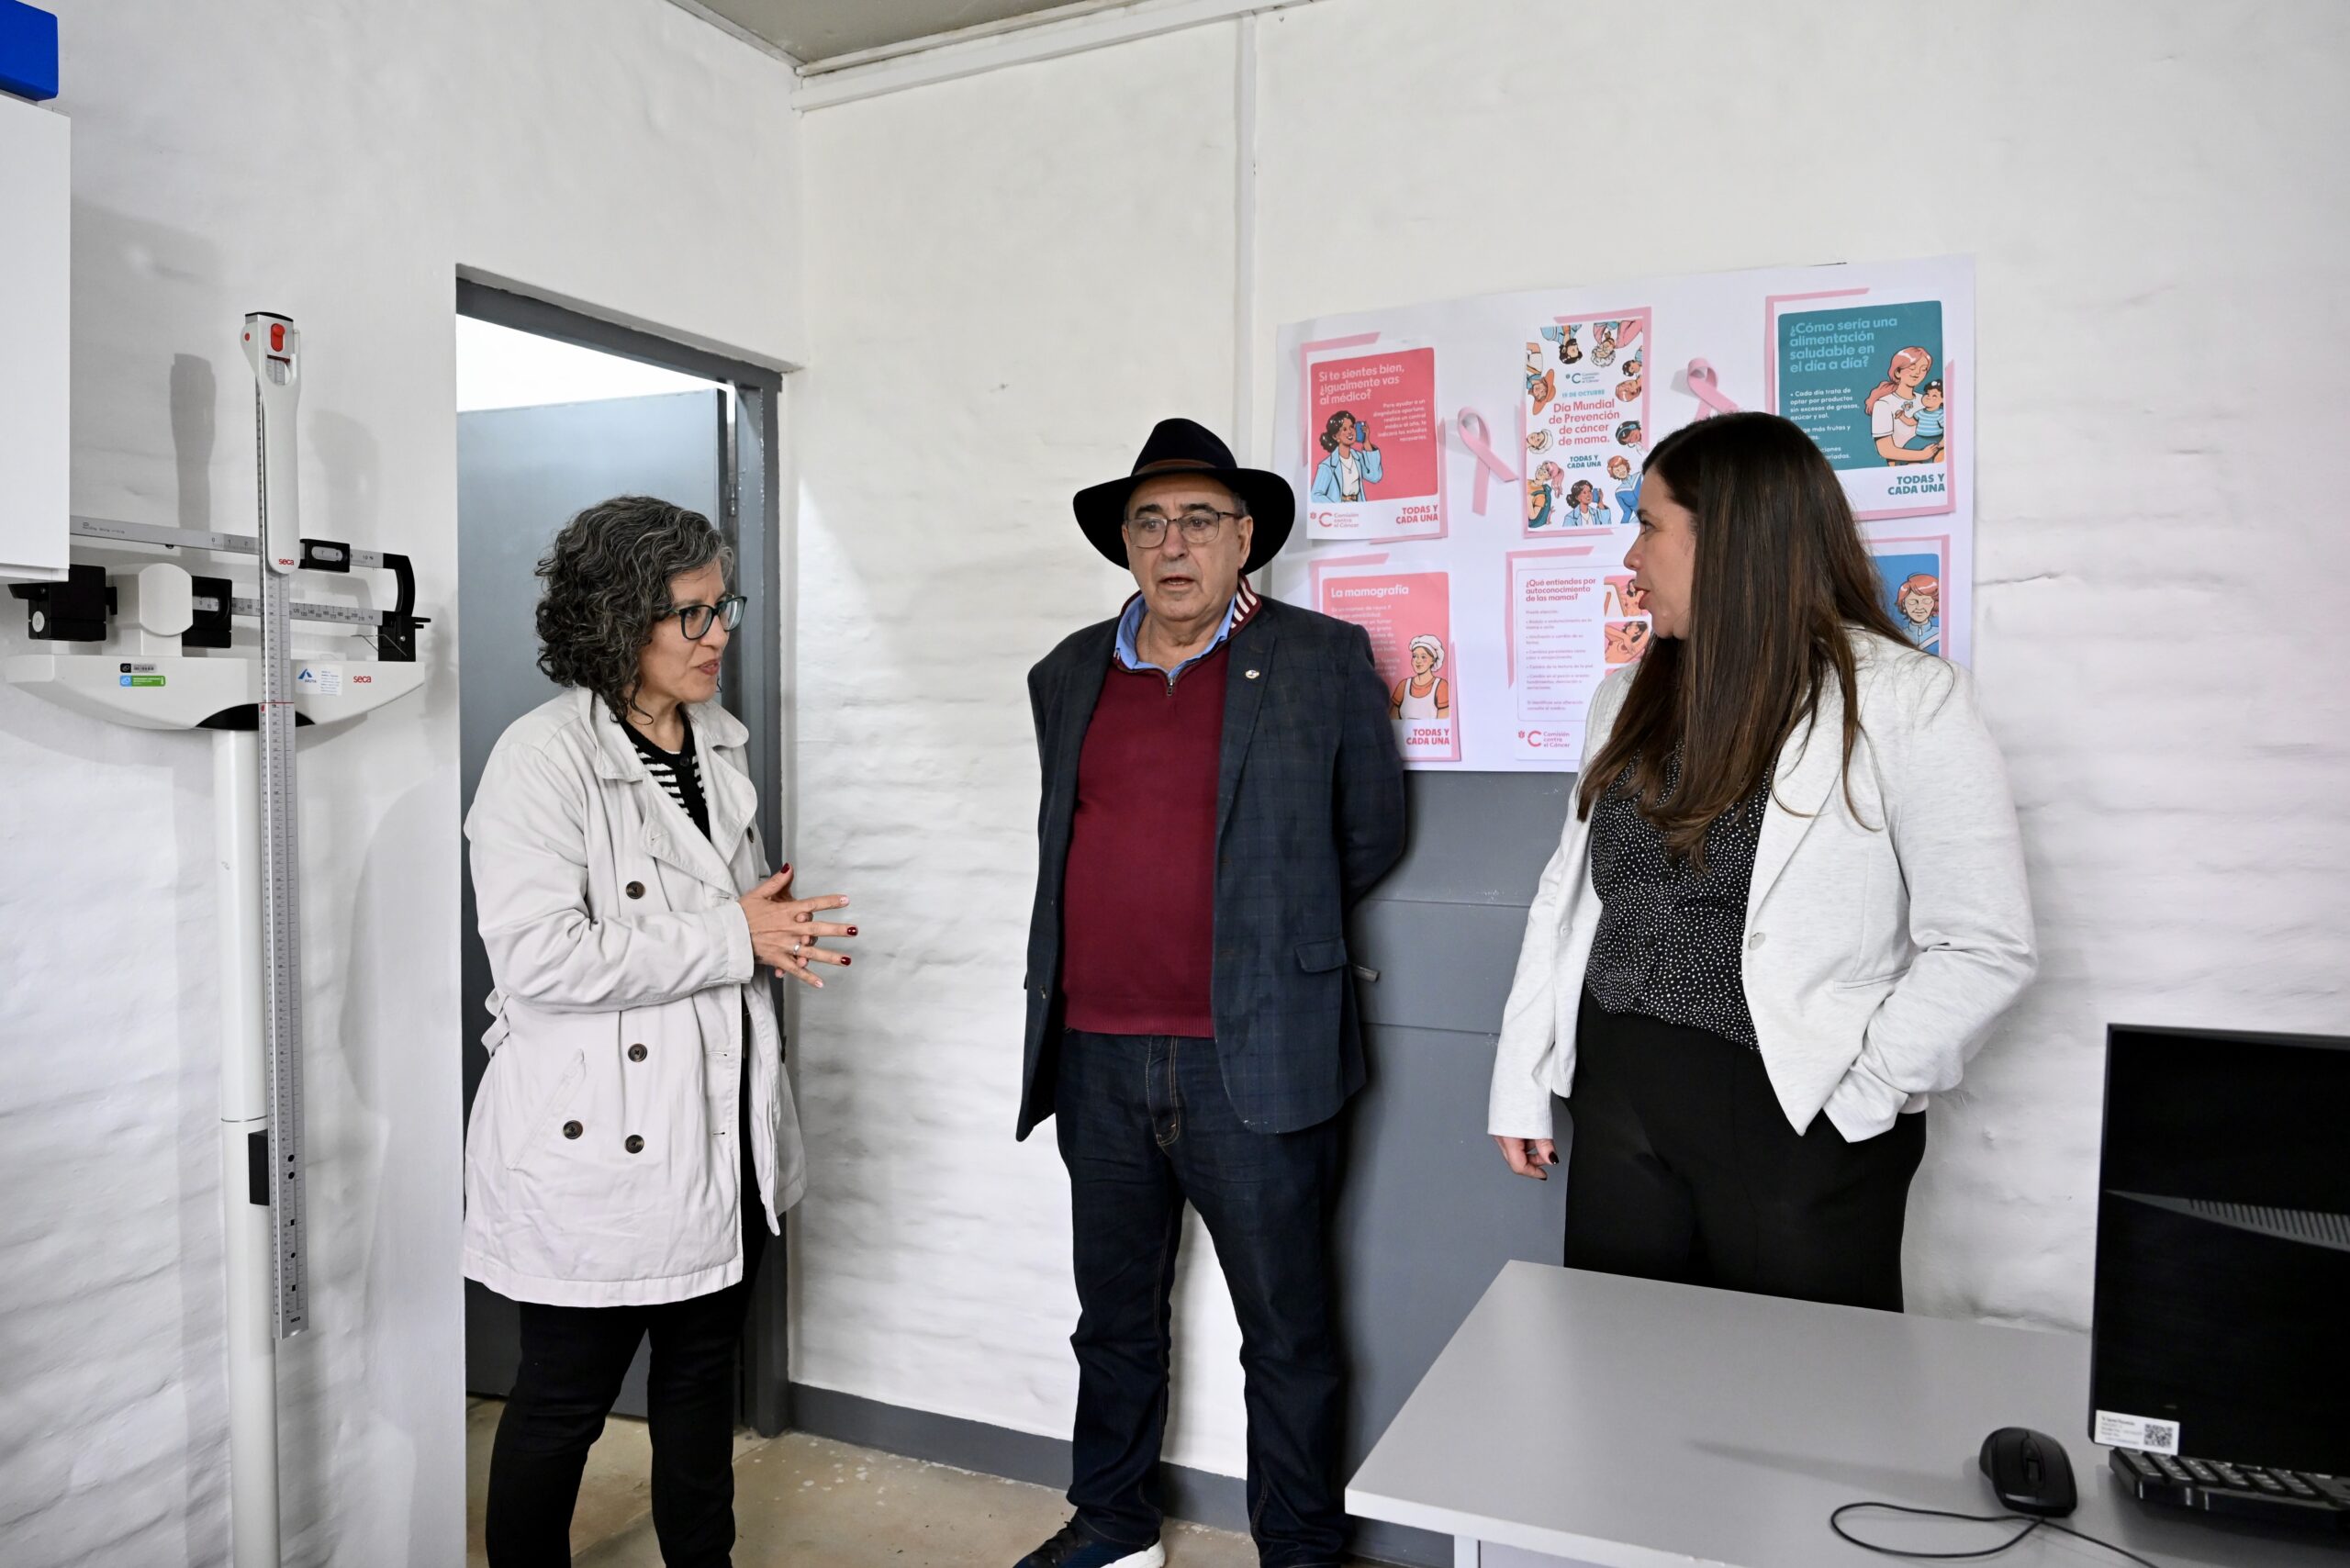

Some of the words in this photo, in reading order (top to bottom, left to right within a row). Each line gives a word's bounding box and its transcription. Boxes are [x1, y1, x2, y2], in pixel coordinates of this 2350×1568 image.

[1789, 321, 1835, 337] ¿Cómo
[1837, 318, 1870, 330] sería
[1873, 318, 1897, 328] una
[1789, 330, 1874, 347] alimentación
[1789, 344, 1855, 360] saludable
[1858, 345, 1874, 354] en
[1790, 361, 1802, 373] el
[1805, 359, 1826, 372] día
[1829, 361, 1838, 370] a
[1841, 355, 1869, 369] día?
[1319, 371, 1327, 382] Si
[1329, 372, 1340, 380] te
[1341, 367, 1377, 379] sientes
[1380, 364, 1404, 375] bien,
[1320, 378, 1380, 396] ¿igualmente
[1382, 376, 1400, 386] vas
[1320, 395, 1329, 405] al
[1331, 389, 1371, 404] médico?
[1553, 402, 1572, 413] Día
[1573, 398, 1615, 411] Mundial
[1549, 415, 1562, 424] de
[1564, 410, 1620, 422] Prevención
[1559, 425, 1572, 435] de
[1574, 423, 1609, 433] cáncer
[1559, 436, 1572, 446] de
[1574, 435, 1610, 445] mama.
[1897, 474, 1934, 485] TODAS
[1937, 473, 1944, 482] Y
[1887, 485, 1918, 495] CADA
[1920, 483, 1945, 493] UNA
[1402, 505, 1430, 514] TODAS
[1433, 504, 1438, 512] Y
[1395, 515, 1418, 524] CADA
[1420, 513, 1438, 522] UNA
[1526, 578, 1544, 588] ¿Qué
[1546, 577, 1582, 586] entiendes
[1583, 578, 1596, 588] por
[1331, 588, 1343, 598] La
[1345, 584, 1409, 598] mamografía
[1526, 587, 1591, 595] autoconocimiento
[1549, 593, 1579, 601] mamas?
[1413, 728, 1441, 736] TODAS
[1444, 728, 1449, 736] Y
